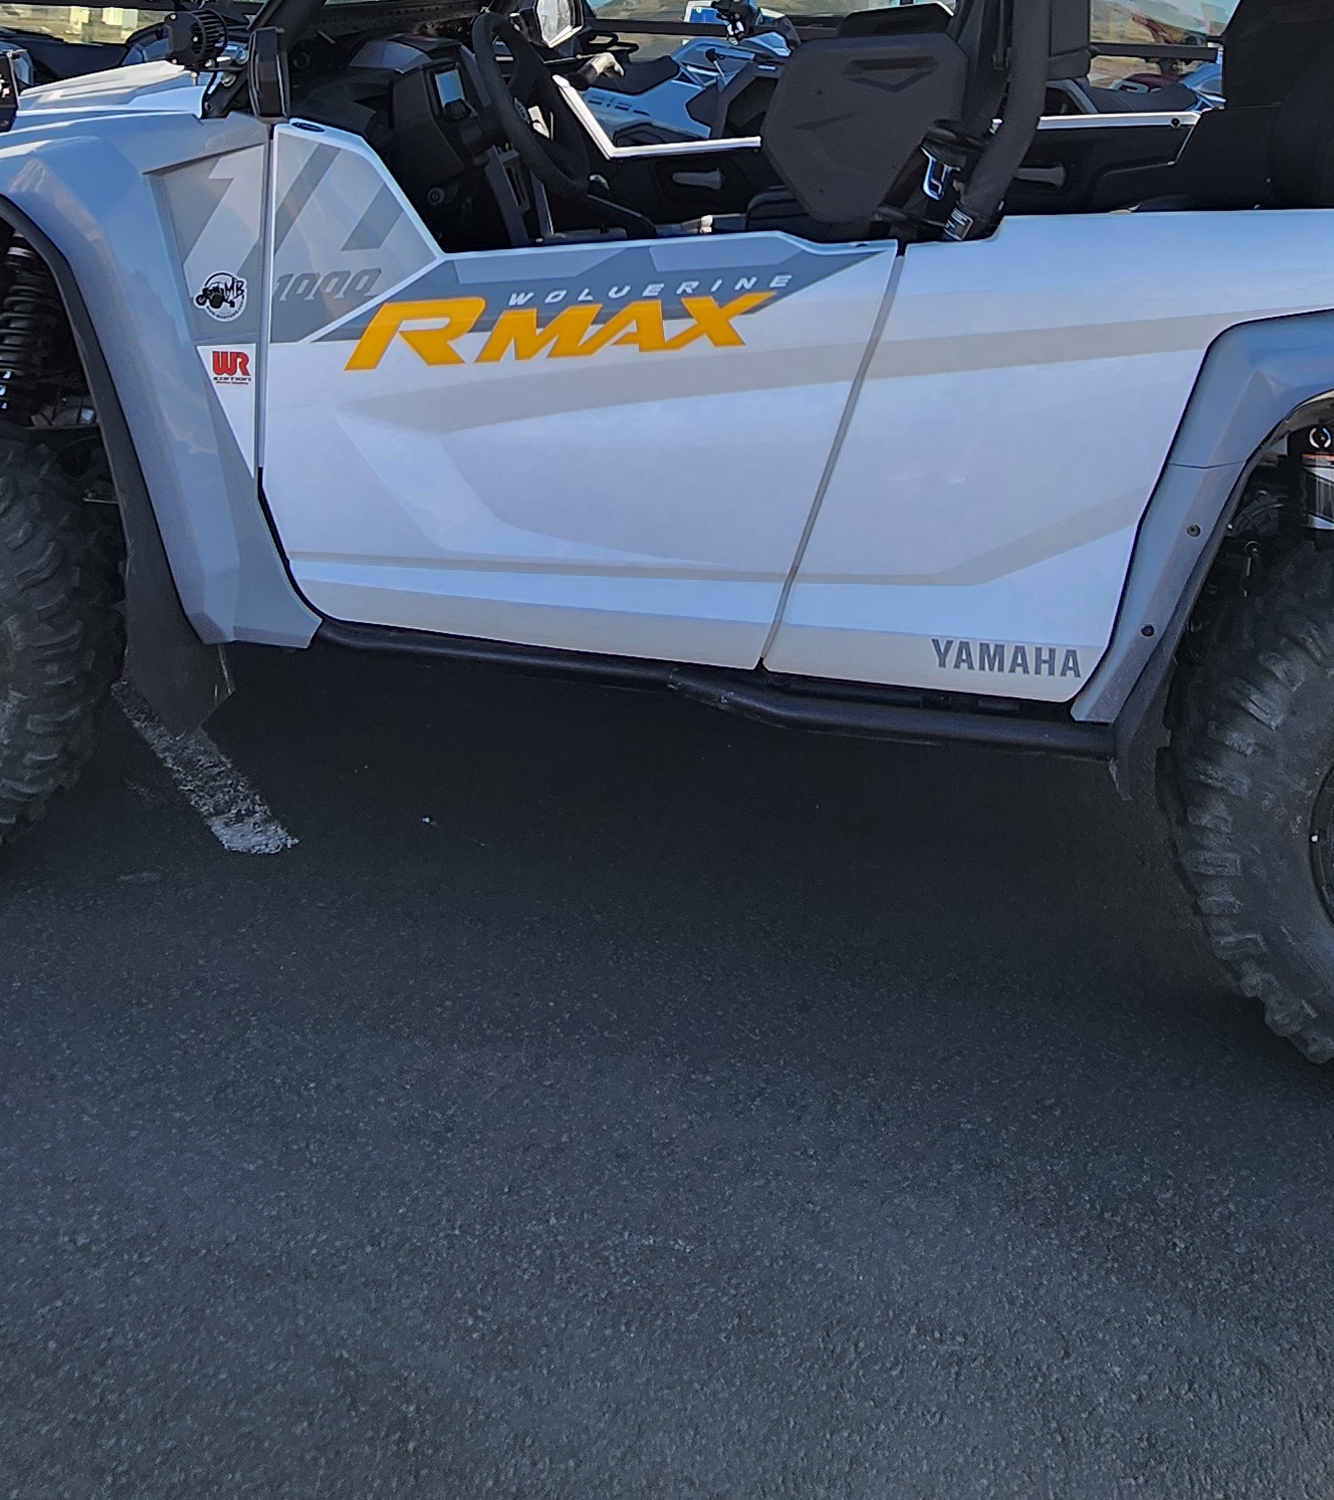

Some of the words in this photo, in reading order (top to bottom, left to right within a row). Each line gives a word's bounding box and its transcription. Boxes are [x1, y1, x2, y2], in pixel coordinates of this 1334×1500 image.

[274, 268, 382, 300] 1000
[507, 275, 793, 306] WOLVERINE
[344, 291, 777, 370] RMAX
[212, 351, 250, 376] WR
[931, 639, 1081, 678] YAMAHA
